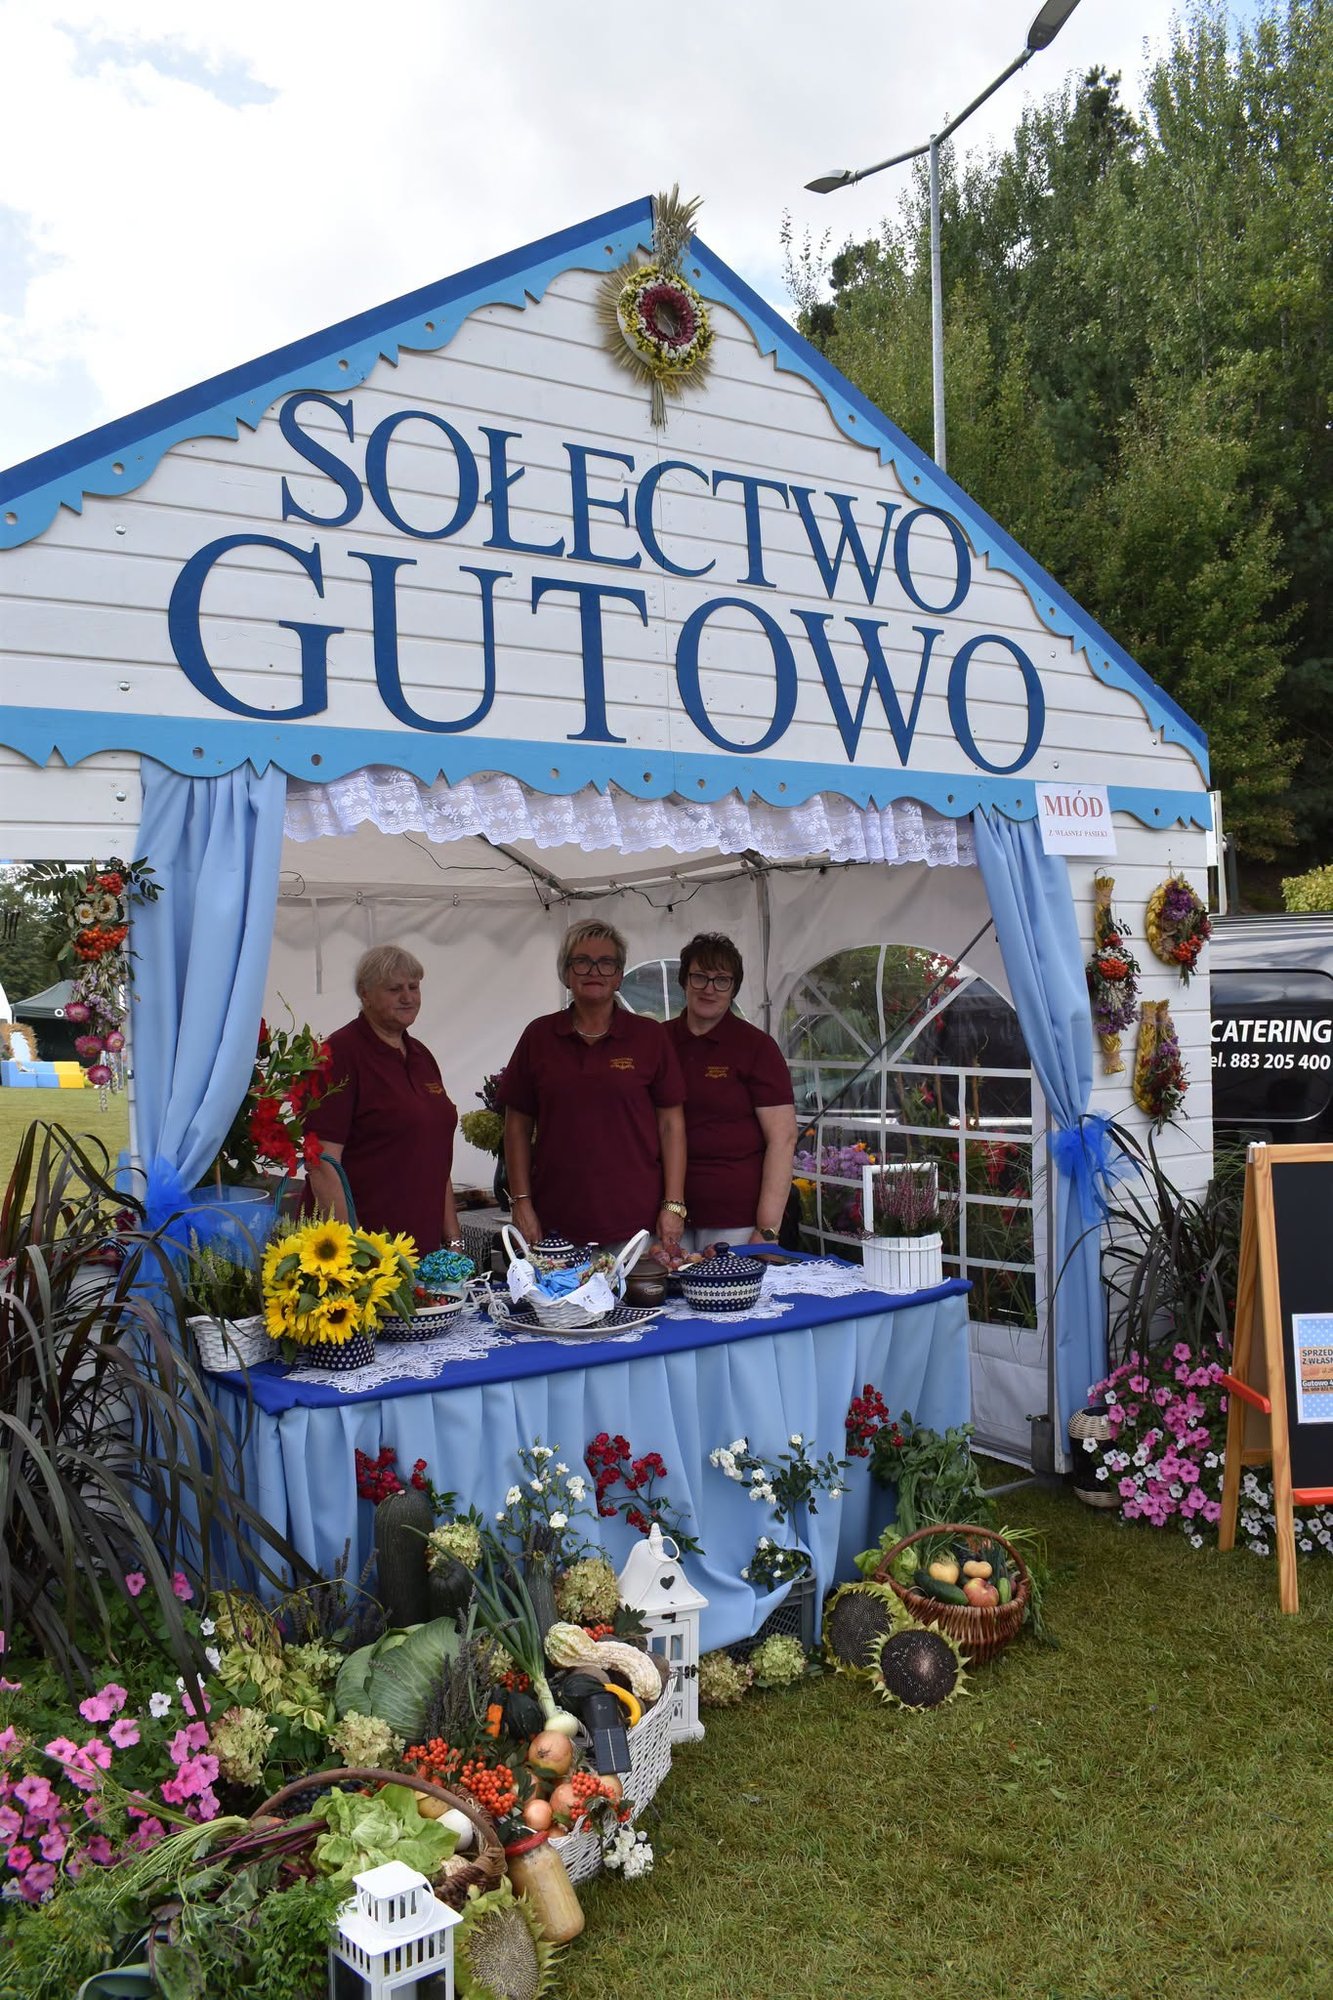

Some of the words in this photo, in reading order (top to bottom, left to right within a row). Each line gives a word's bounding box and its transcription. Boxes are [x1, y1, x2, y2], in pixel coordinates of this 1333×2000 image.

[280, 391, 972, 615] SOŁECTWO
[168, 533, 1046, 775] GUTOWO
[1043, 790, 1104, 818] MIÓD
[1210, 1019, 1333, 1043] CATERING
[1211, 1052, 1227, 1068] el.
[1230, 1053, 1260, 1068] 883
[1263, 1053, 1295, 1069] 205
[1298, 1054, 1331, 1070] 400
[1302, 1349, 1333, 1357] SPRZED
